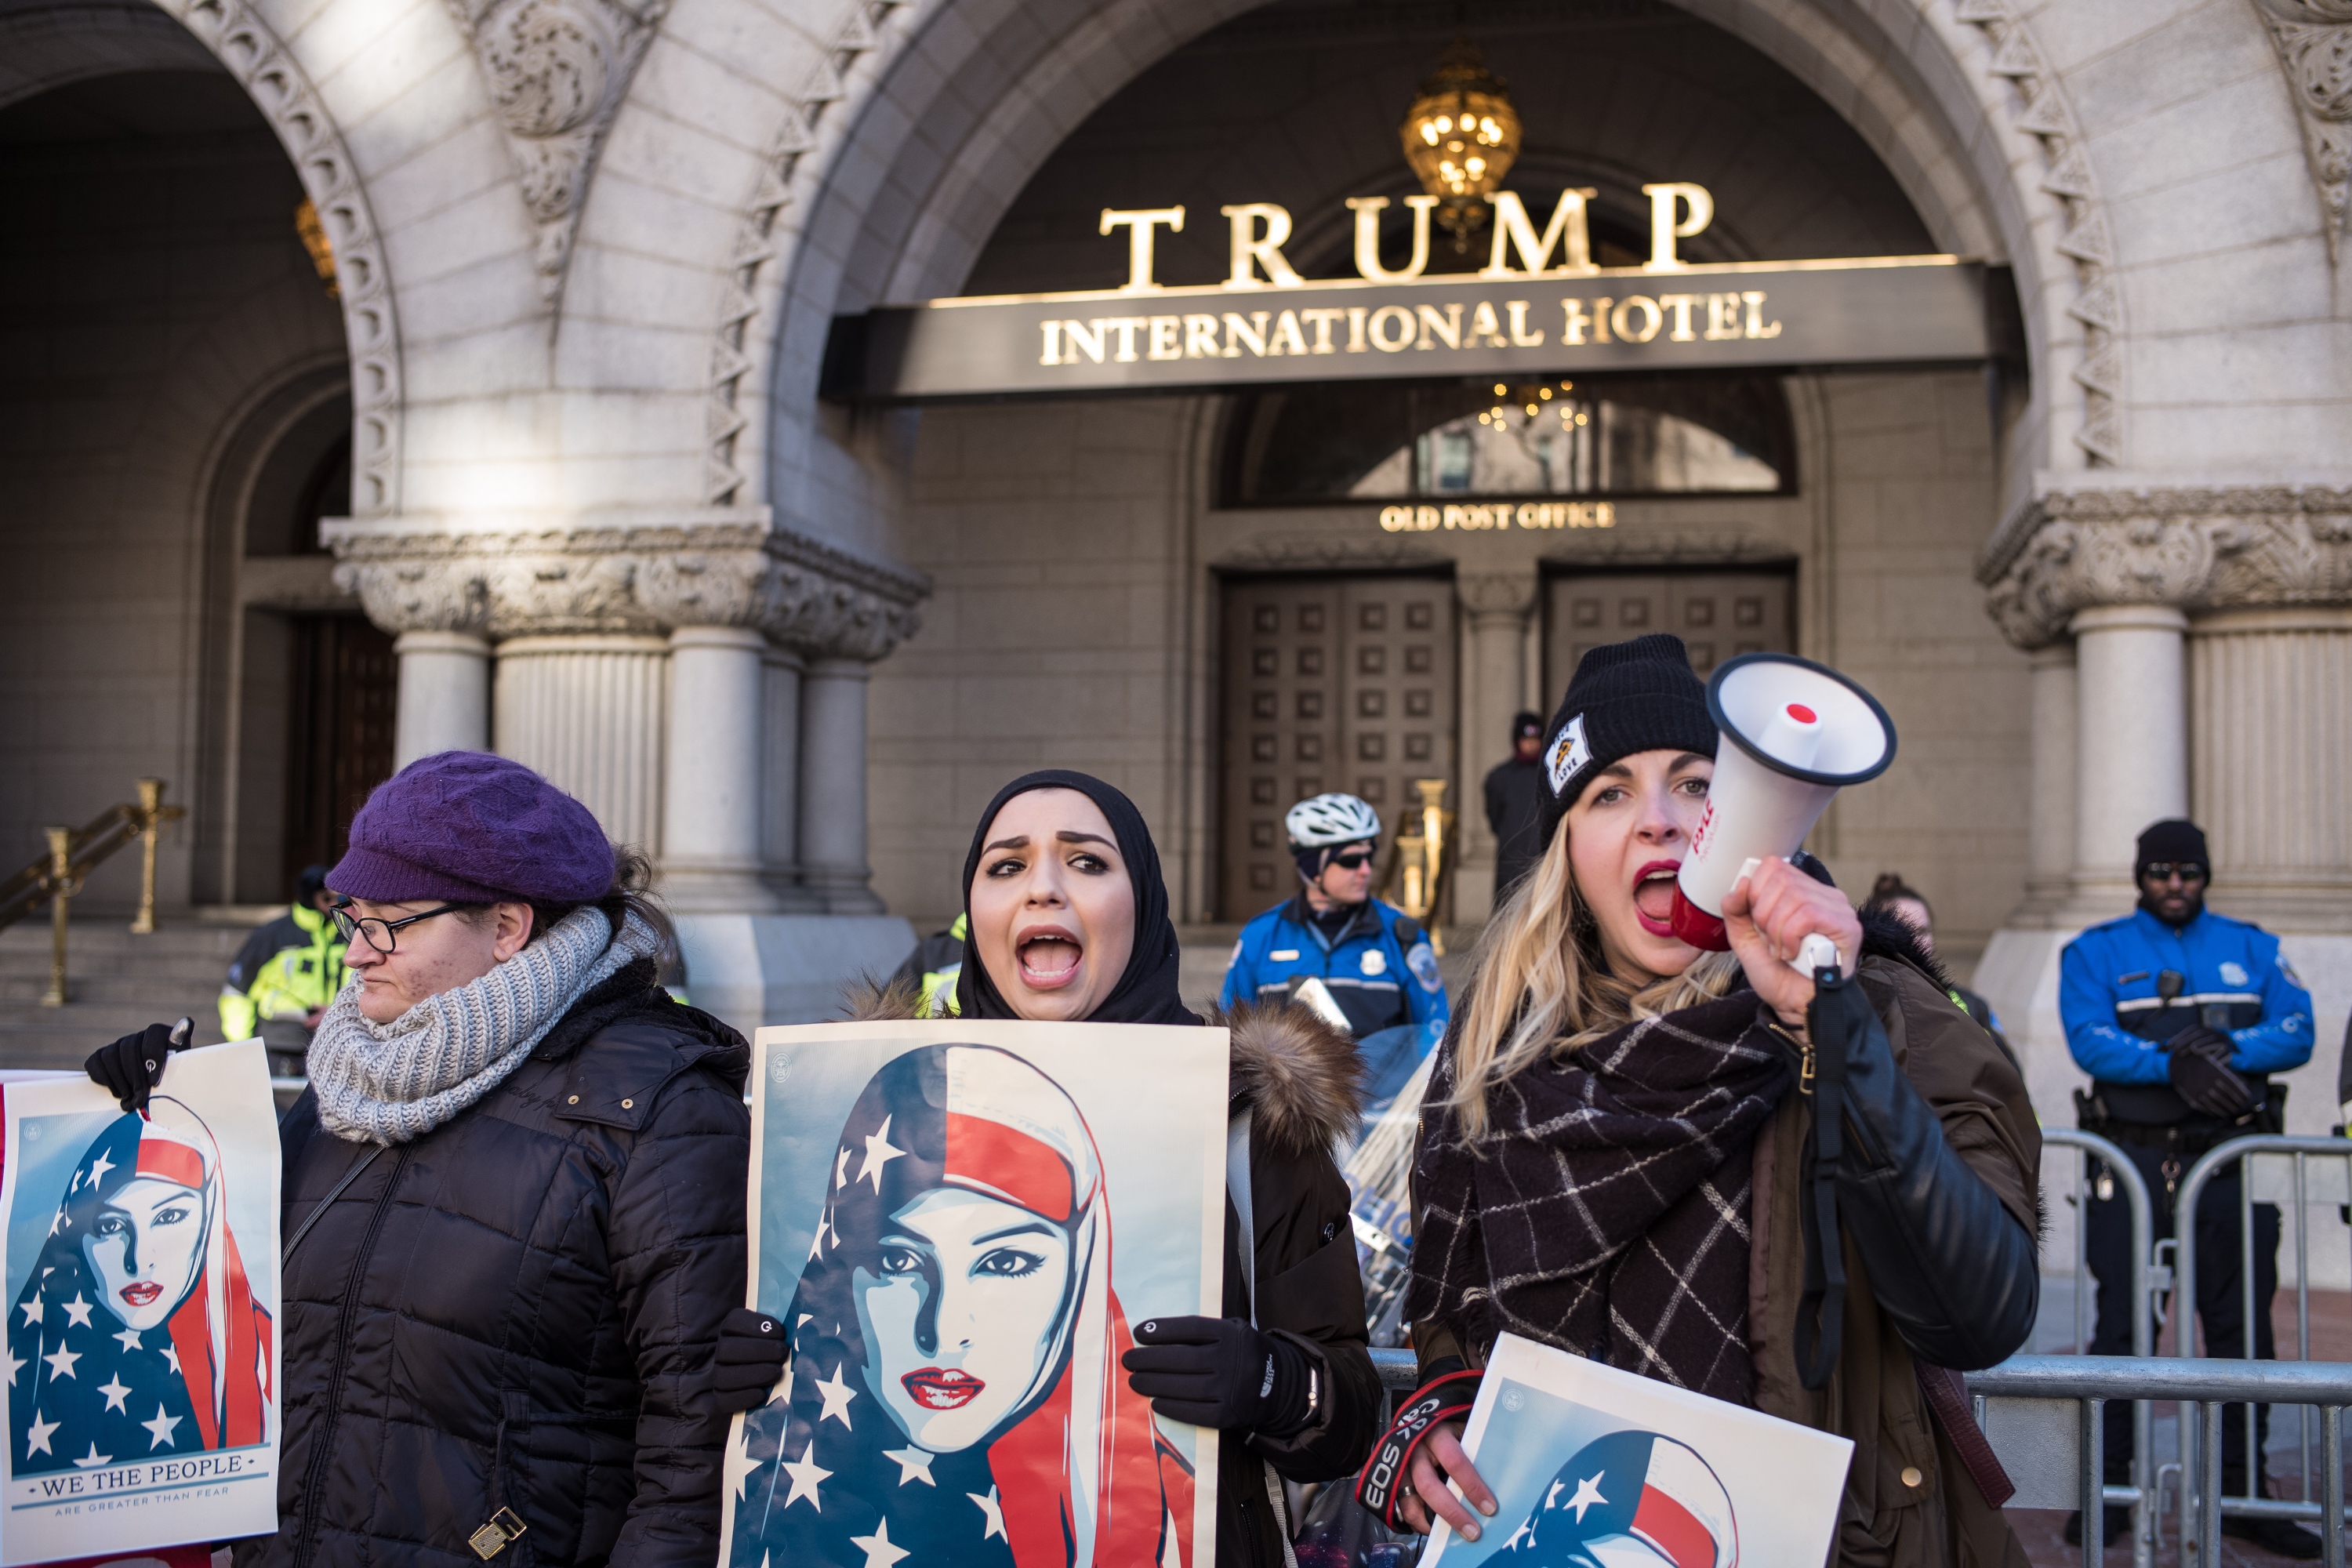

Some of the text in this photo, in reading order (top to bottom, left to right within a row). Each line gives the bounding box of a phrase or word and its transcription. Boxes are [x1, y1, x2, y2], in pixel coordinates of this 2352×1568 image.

[1099, 181, 1715, 295] TRUMP
[1039, 291, 1782, 365] INTERNATIONAL HOTEL
[1379, 501, 1617, 532] OLD POST OFFICE
[1558, 757, 1577, 781] LOVE
[42, 1455, 242, 1497] WE THE PEOPLE
[1365, 1443, 1400, 1509] EOS
[55, 1486, 229, 1517] ARE GREATER THAN FEAR
